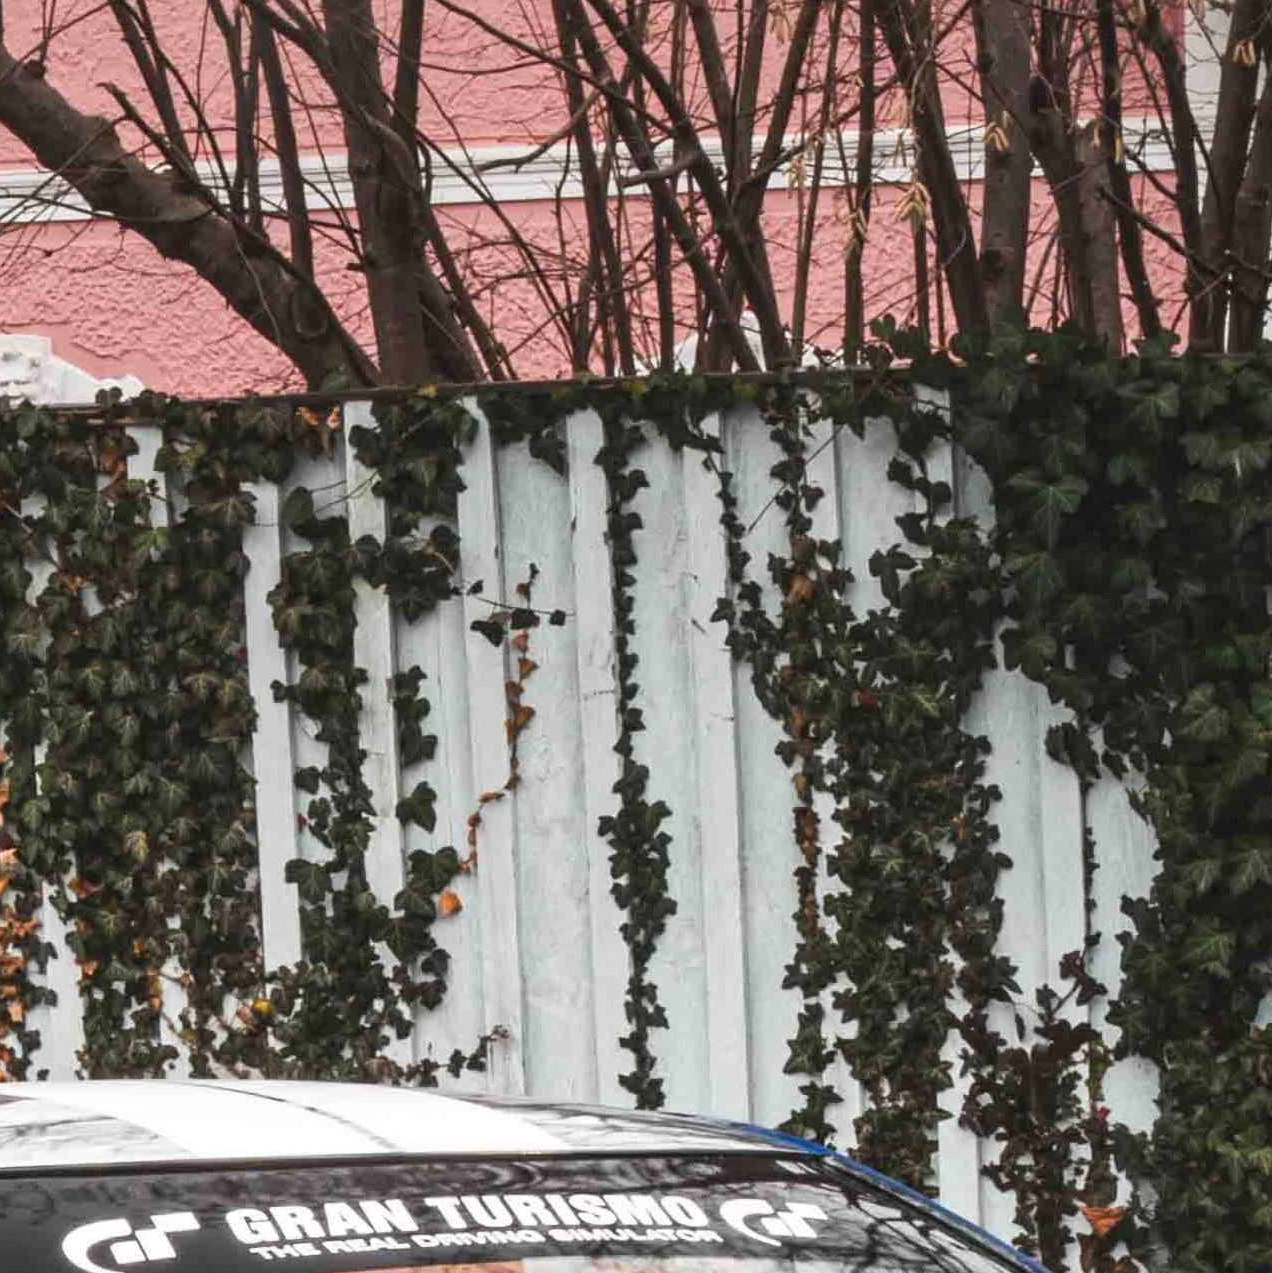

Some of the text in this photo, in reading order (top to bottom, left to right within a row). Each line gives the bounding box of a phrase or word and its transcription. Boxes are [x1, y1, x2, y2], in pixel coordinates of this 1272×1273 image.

[225, 1199, 419, 1245] GRAN
[424, 1193, 710, 1230] TURISMO
[250, 1229, 724, 1261] THE REAL DRIVING SIMULATOR
